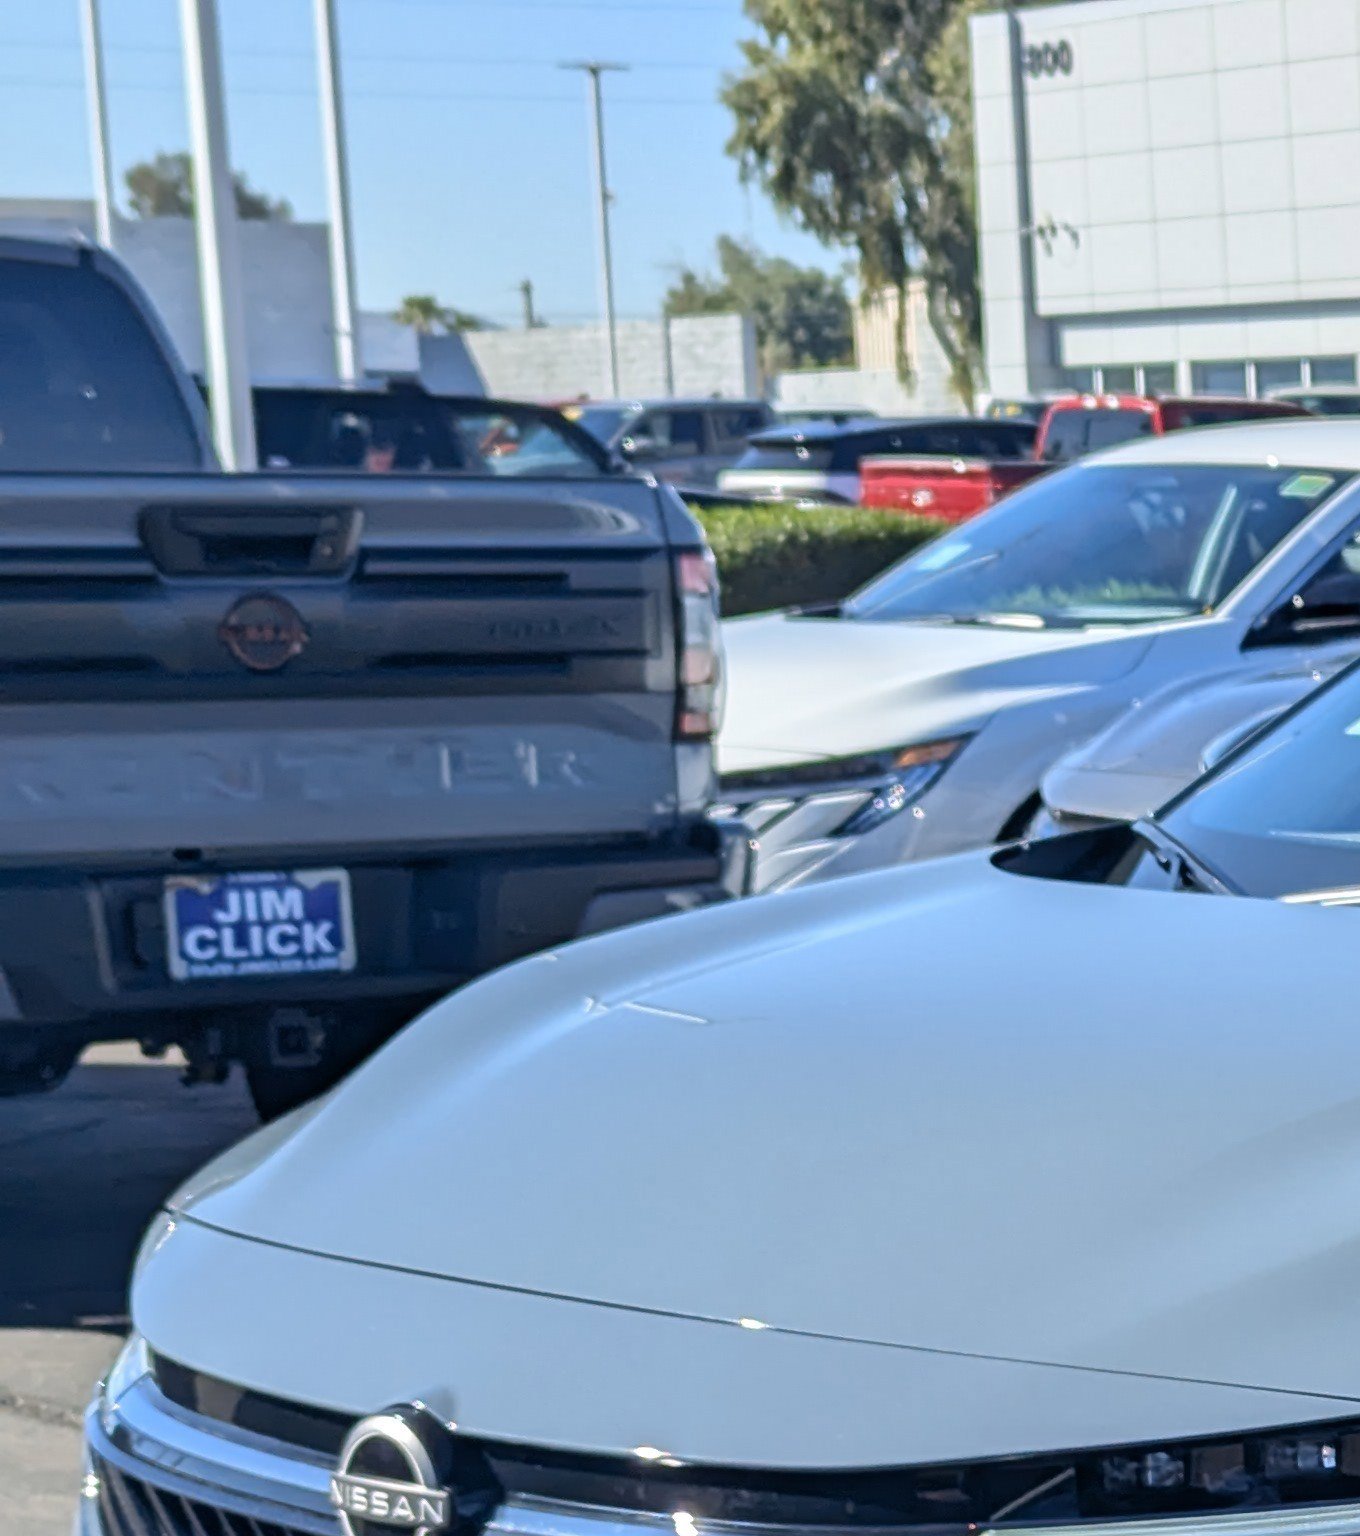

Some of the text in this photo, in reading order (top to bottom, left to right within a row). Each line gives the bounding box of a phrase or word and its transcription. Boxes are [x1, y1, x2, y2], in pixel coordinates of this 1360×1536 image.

[213, 886, 304, 923] JIM
[183, 920, 336, 961] CLICK
[330, 1479, 444, 1524] NISSAN
